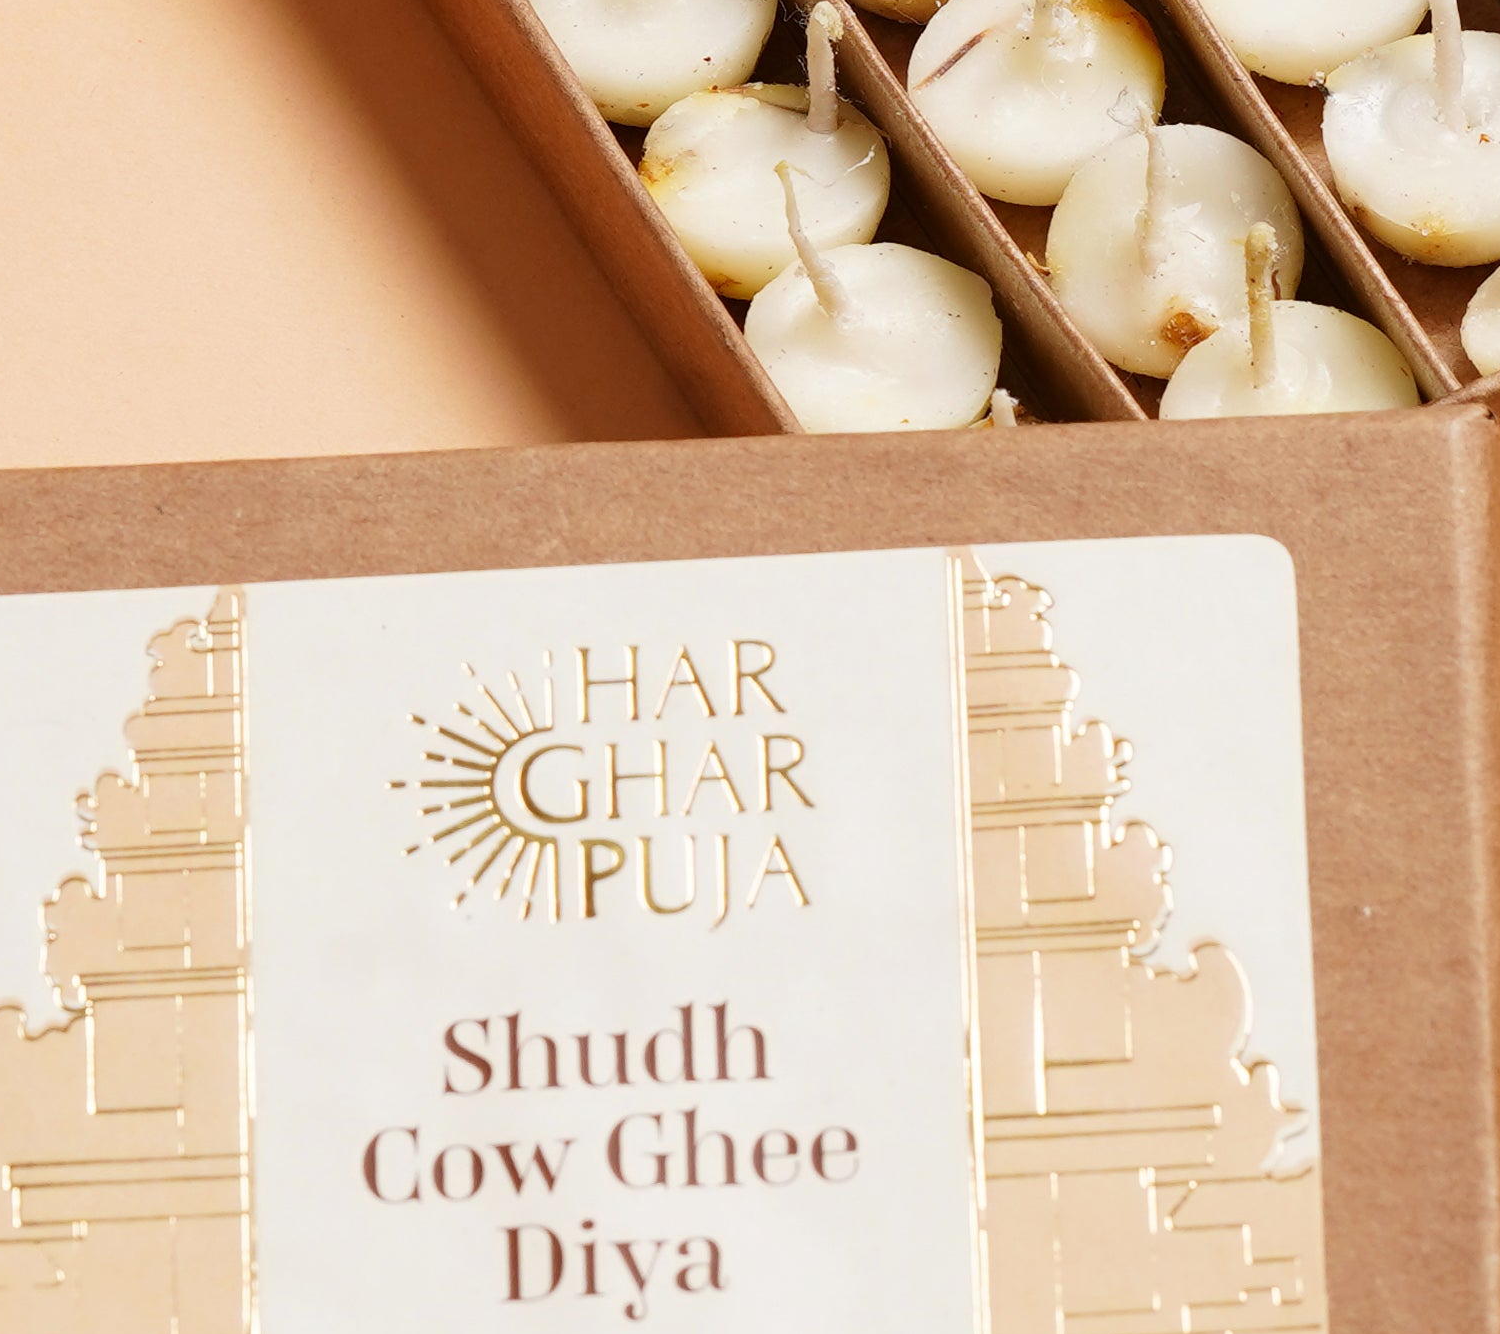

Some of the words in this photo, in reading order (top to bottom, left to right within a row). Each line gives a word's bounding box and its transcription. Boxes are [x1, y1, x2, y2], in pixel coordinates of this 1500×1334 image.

[572, 638, 787, 724] HAR
[516, 733, 815, 824] GHAR
[578, 834, 810, 930] PUJA
[441, 999, 775, 1096] Shudh
[361, 1125, 578, 1205] Cow
[606, 1105, 860, 1191] Ghee
[497, 1219, 730, 1322] Diya
